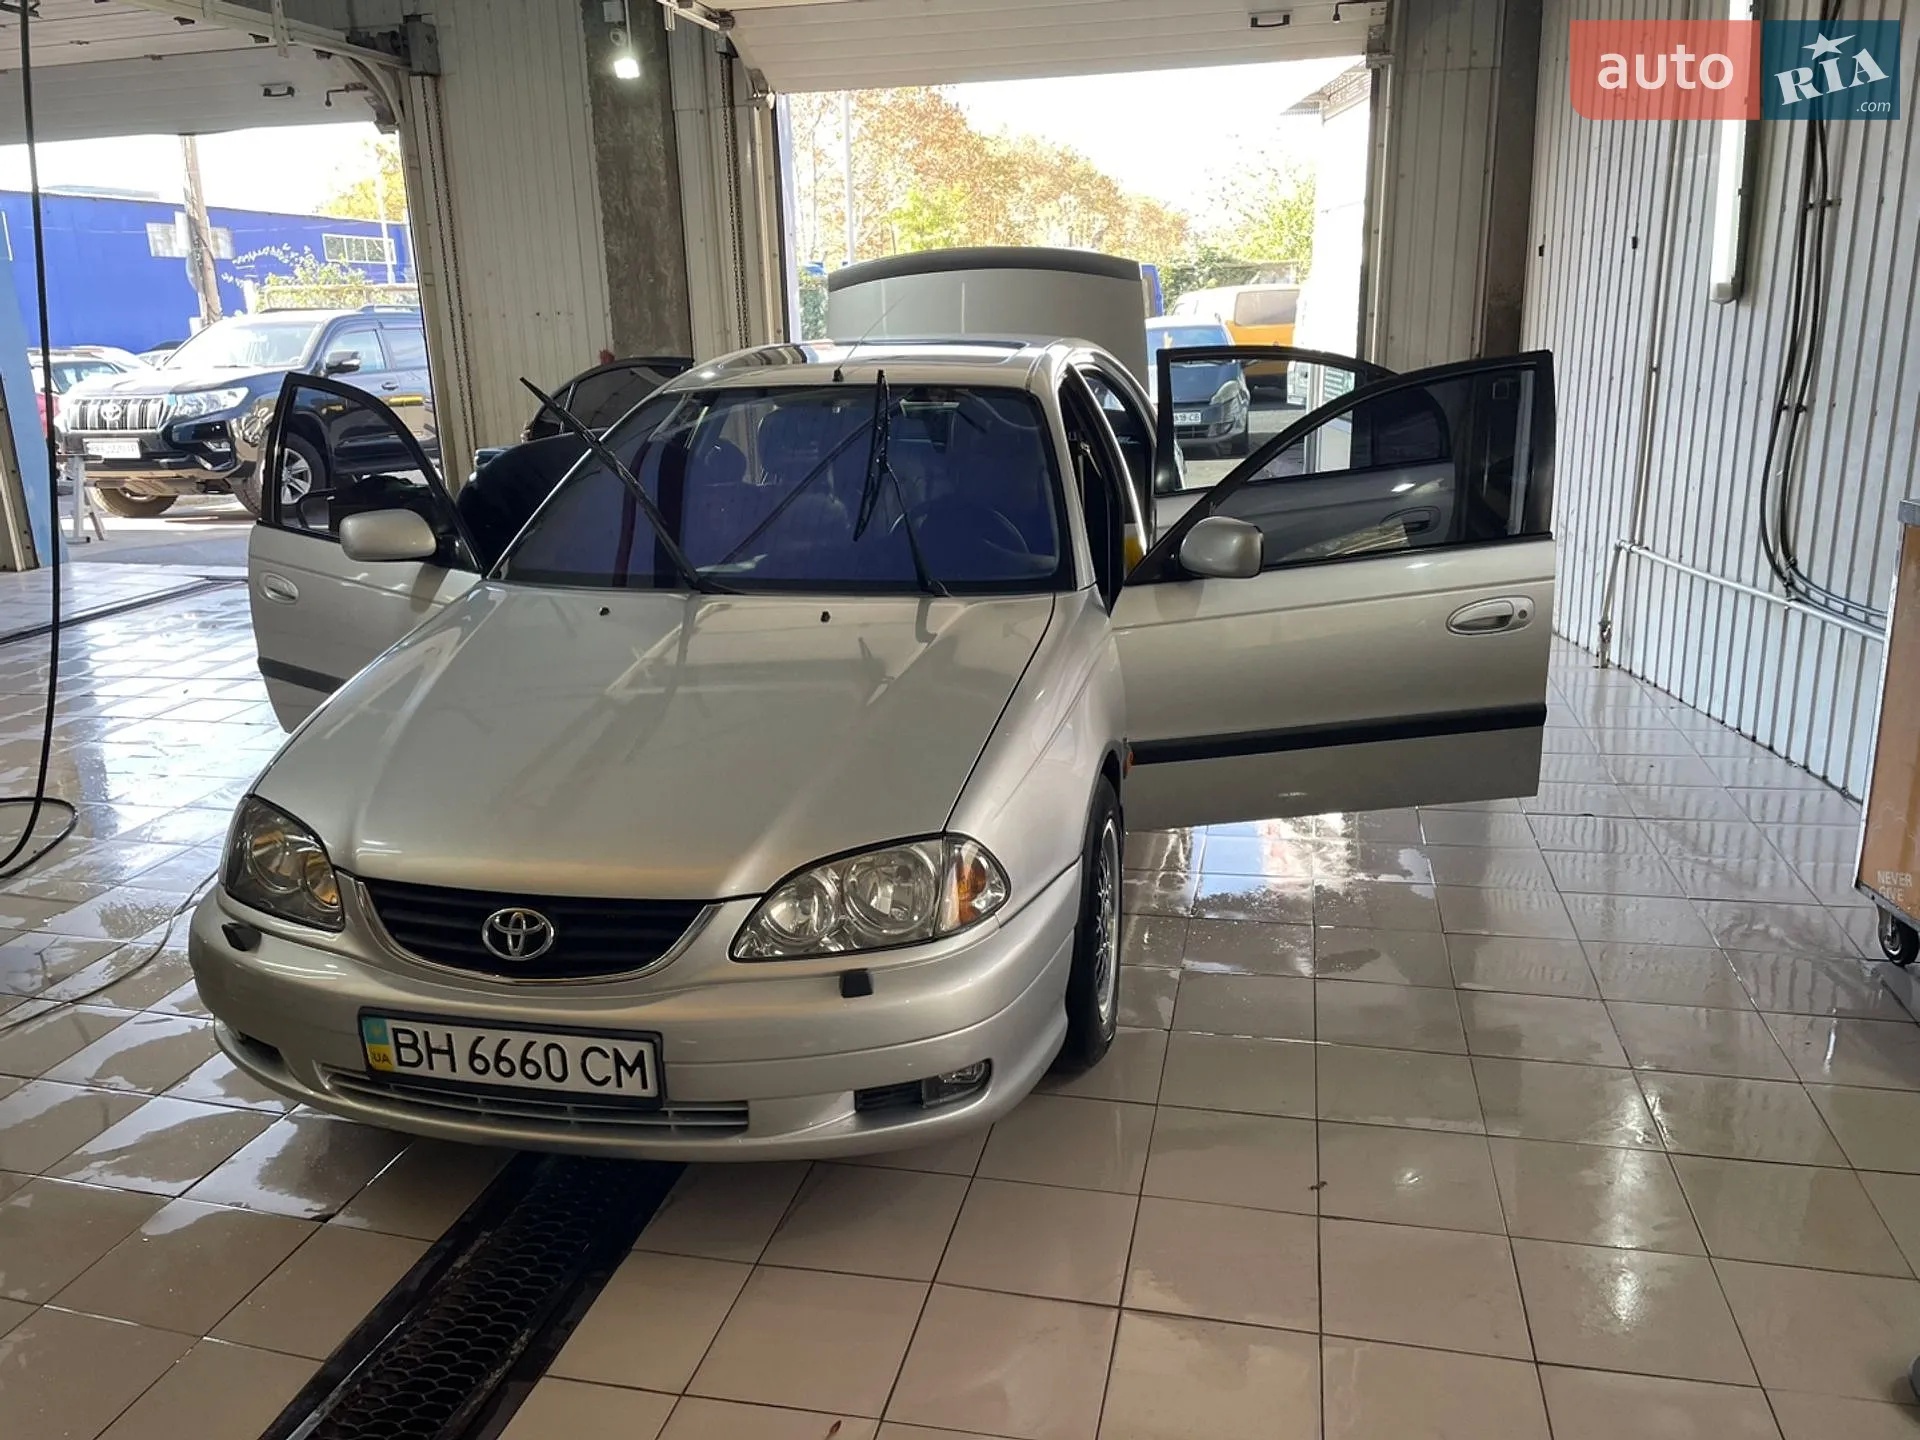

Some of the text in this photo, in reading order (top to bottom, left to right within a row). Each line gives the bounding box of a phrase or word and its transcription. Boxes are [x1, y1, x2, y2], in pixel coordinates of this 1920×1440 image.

[1877, 870, 1913, 887] NEVER
[1878, 886, 1905, 901] GIVE
[374, 1051, 392, 1066] UA
[391, 1027, 649, 1090] BH 6660 CM
